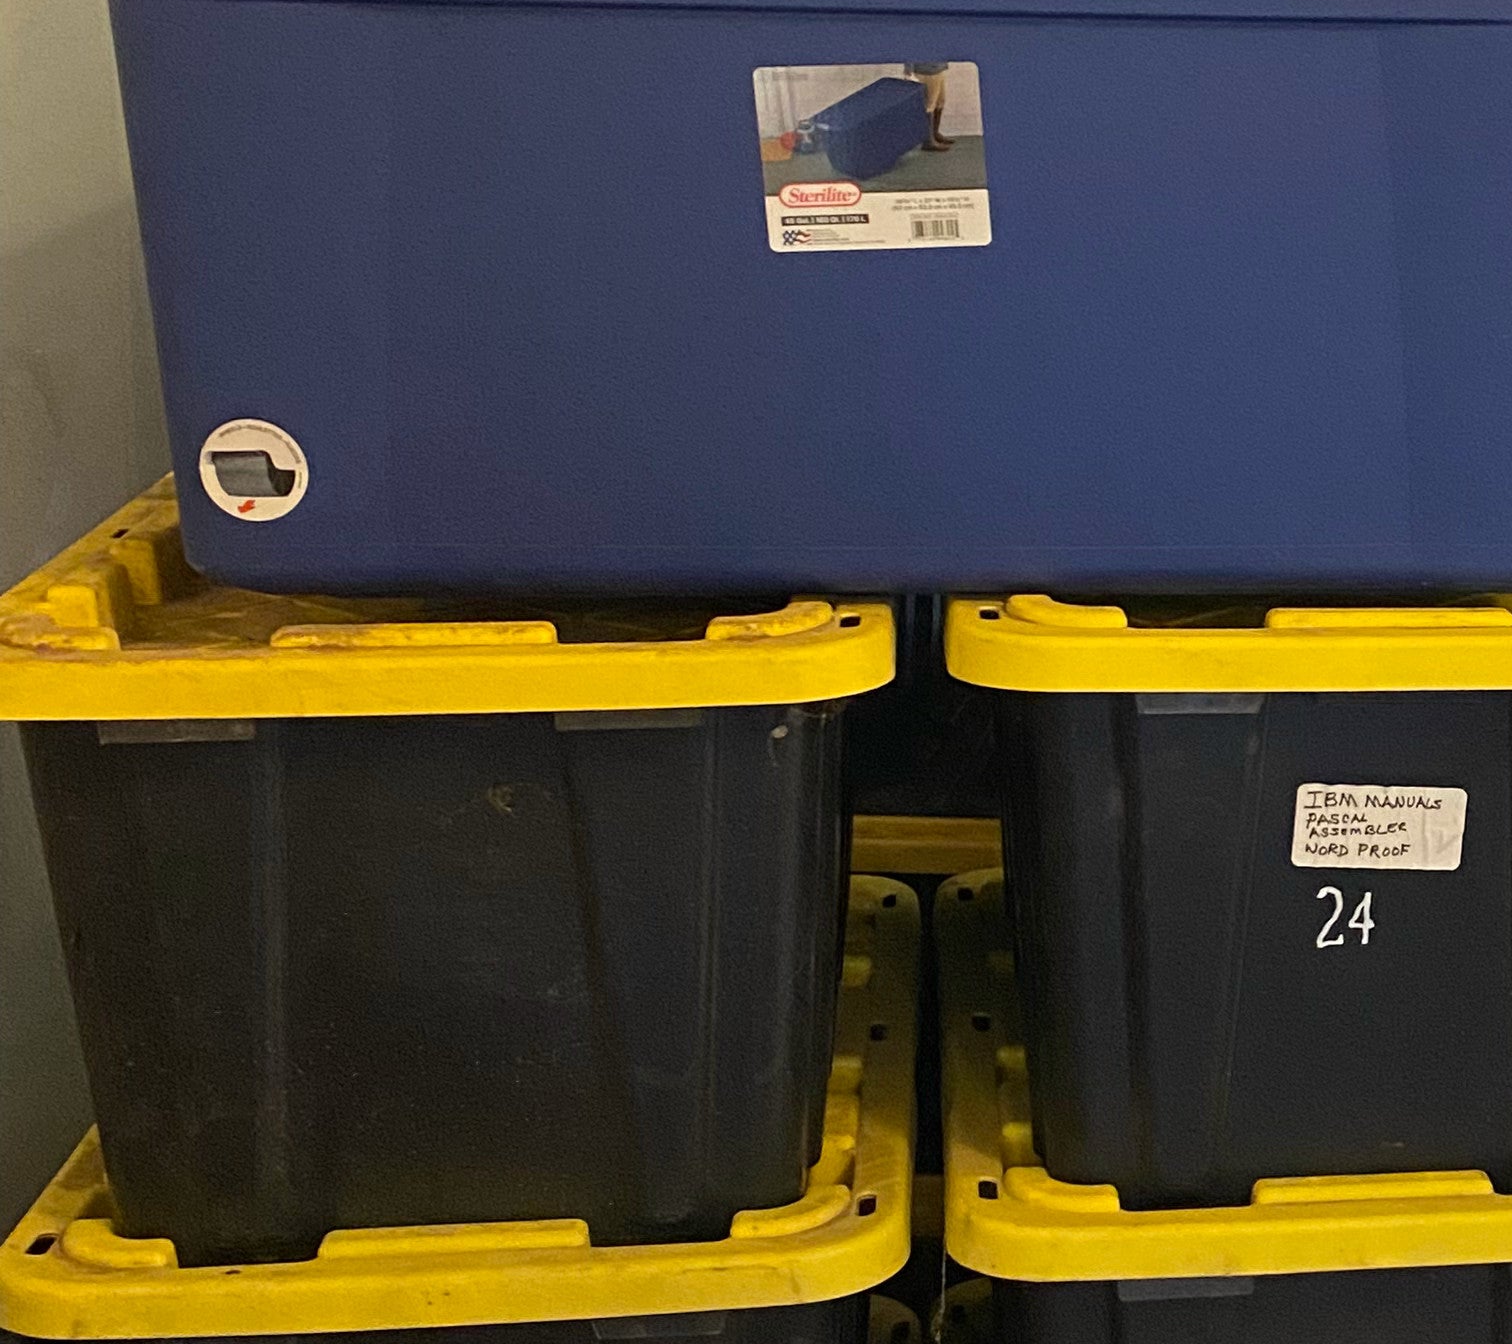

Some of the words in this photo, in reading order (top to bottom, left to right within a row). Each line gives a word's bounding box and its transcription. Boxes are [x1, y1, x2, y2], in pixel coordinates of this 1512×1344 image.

[788, 186, 851, 204] Sterilite
[1304, 791, 1358, 809] IBM
[1365, 794, 1442, 810] MANUALS
[1358, 843, 1411, 859] PROOF
[1316, 886, 1375, 948] 24
